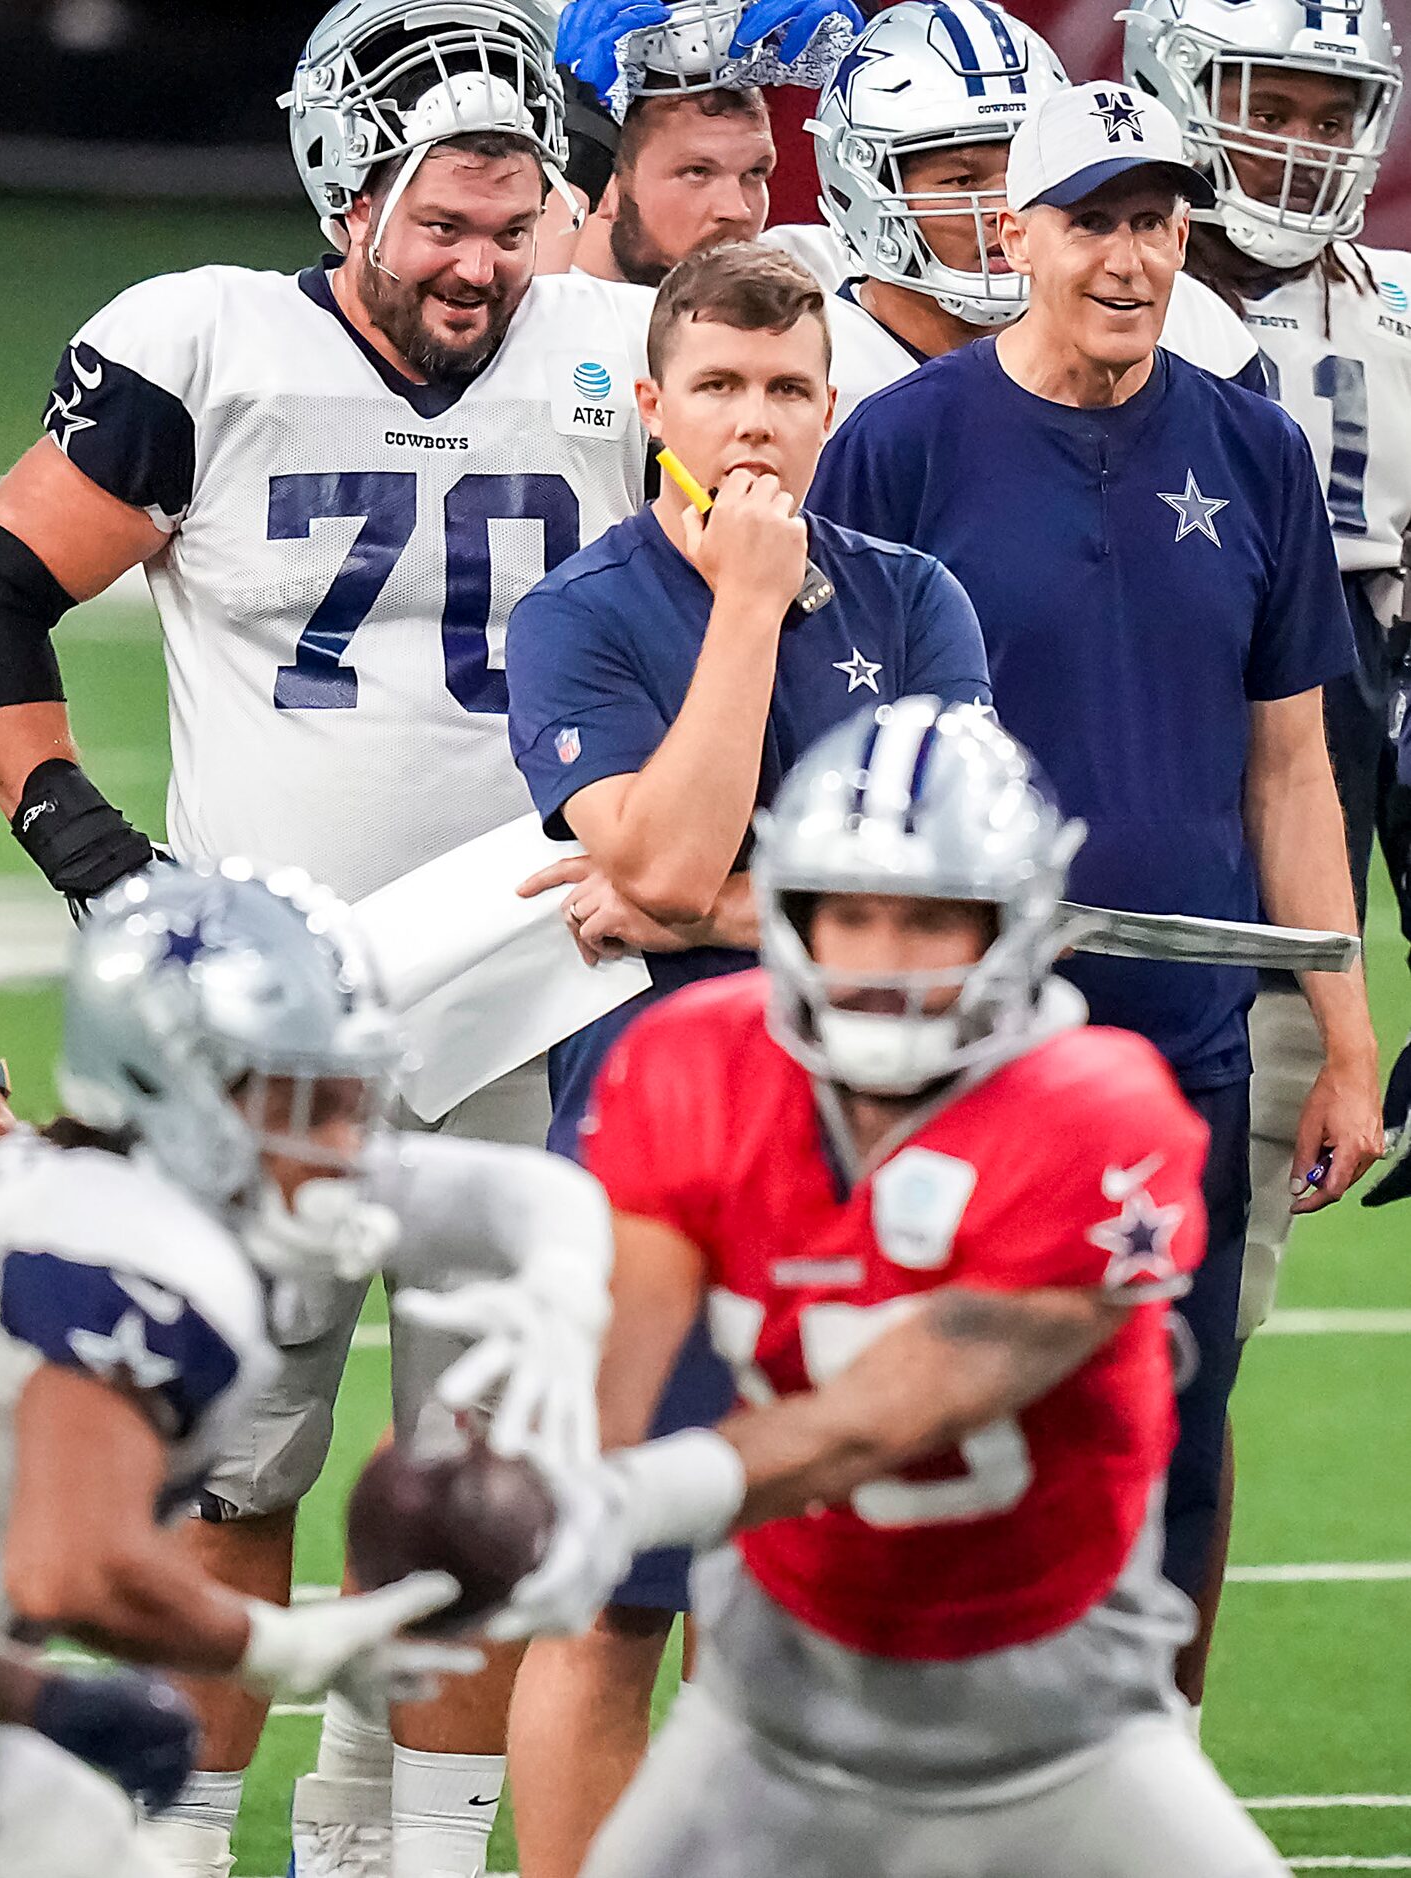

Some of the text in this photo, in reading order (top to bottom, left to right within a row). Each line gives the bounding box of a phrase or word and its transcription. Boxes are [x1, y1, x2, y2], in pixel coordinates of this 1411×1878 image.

[978, 103, 1027, 114] COWBOYS
[573, 407, 615, 427] AT&T
[384, 431, 469, 450] COWBOYS
[267, 472, 580, 714] 70
